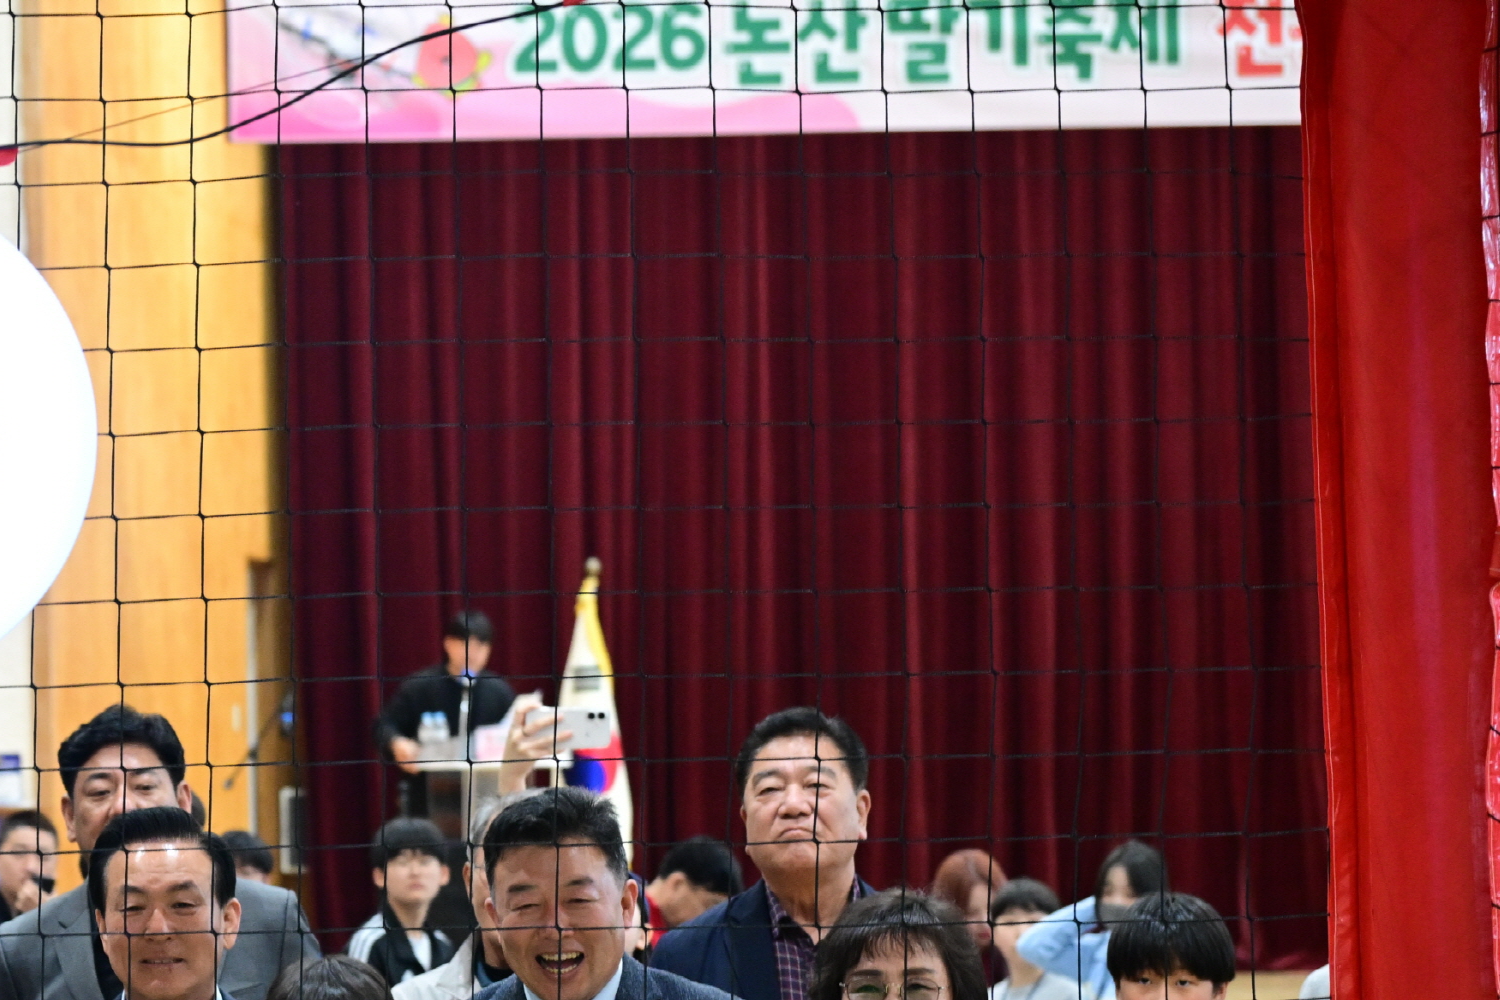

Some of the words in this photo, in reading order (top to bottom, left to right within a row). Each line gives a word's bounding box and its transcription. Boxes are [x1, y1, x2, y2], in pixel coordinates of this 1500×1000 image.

[514, 4, 706, 73] 2026
[725, 0, 868, 85] 논산
[1217, 0, 1300, 78] 전
